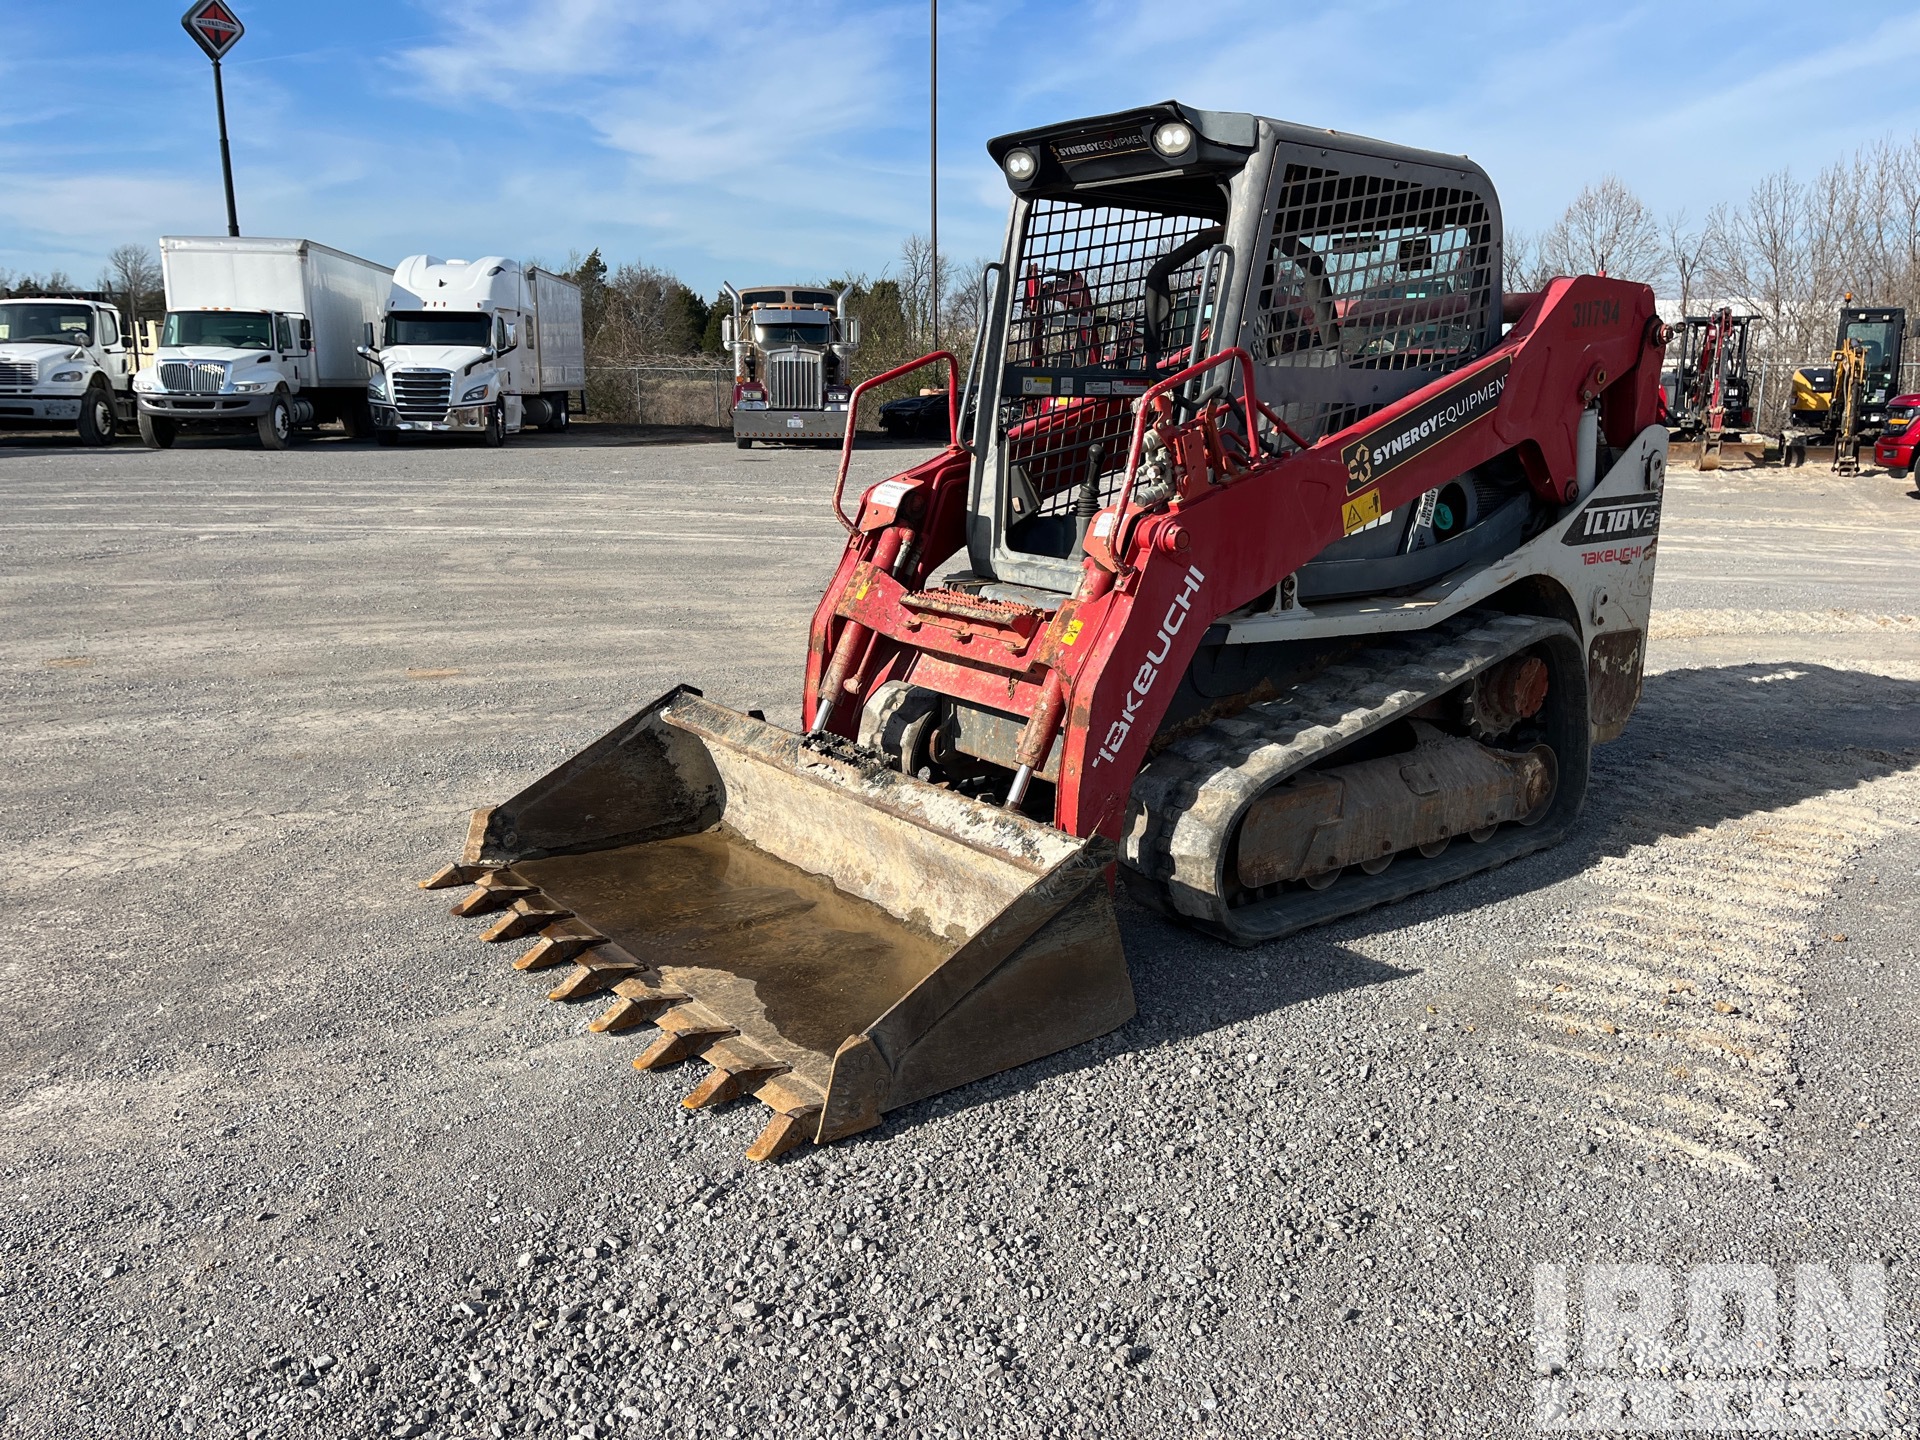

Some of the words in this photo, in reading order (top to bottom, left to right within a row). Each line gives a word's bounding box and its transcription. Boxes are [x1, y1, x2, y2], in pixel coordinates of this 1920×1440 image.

[1058, 134, 1147, 157] SYNERGYEQUIPMEN
[1571, 299, 1621, 328] 311794
[1422, 494, 1431, 518] DIESEL
[1425, 508, 1433, 525] FUEL
[1583, 501, 1658, 536] TL10V2
